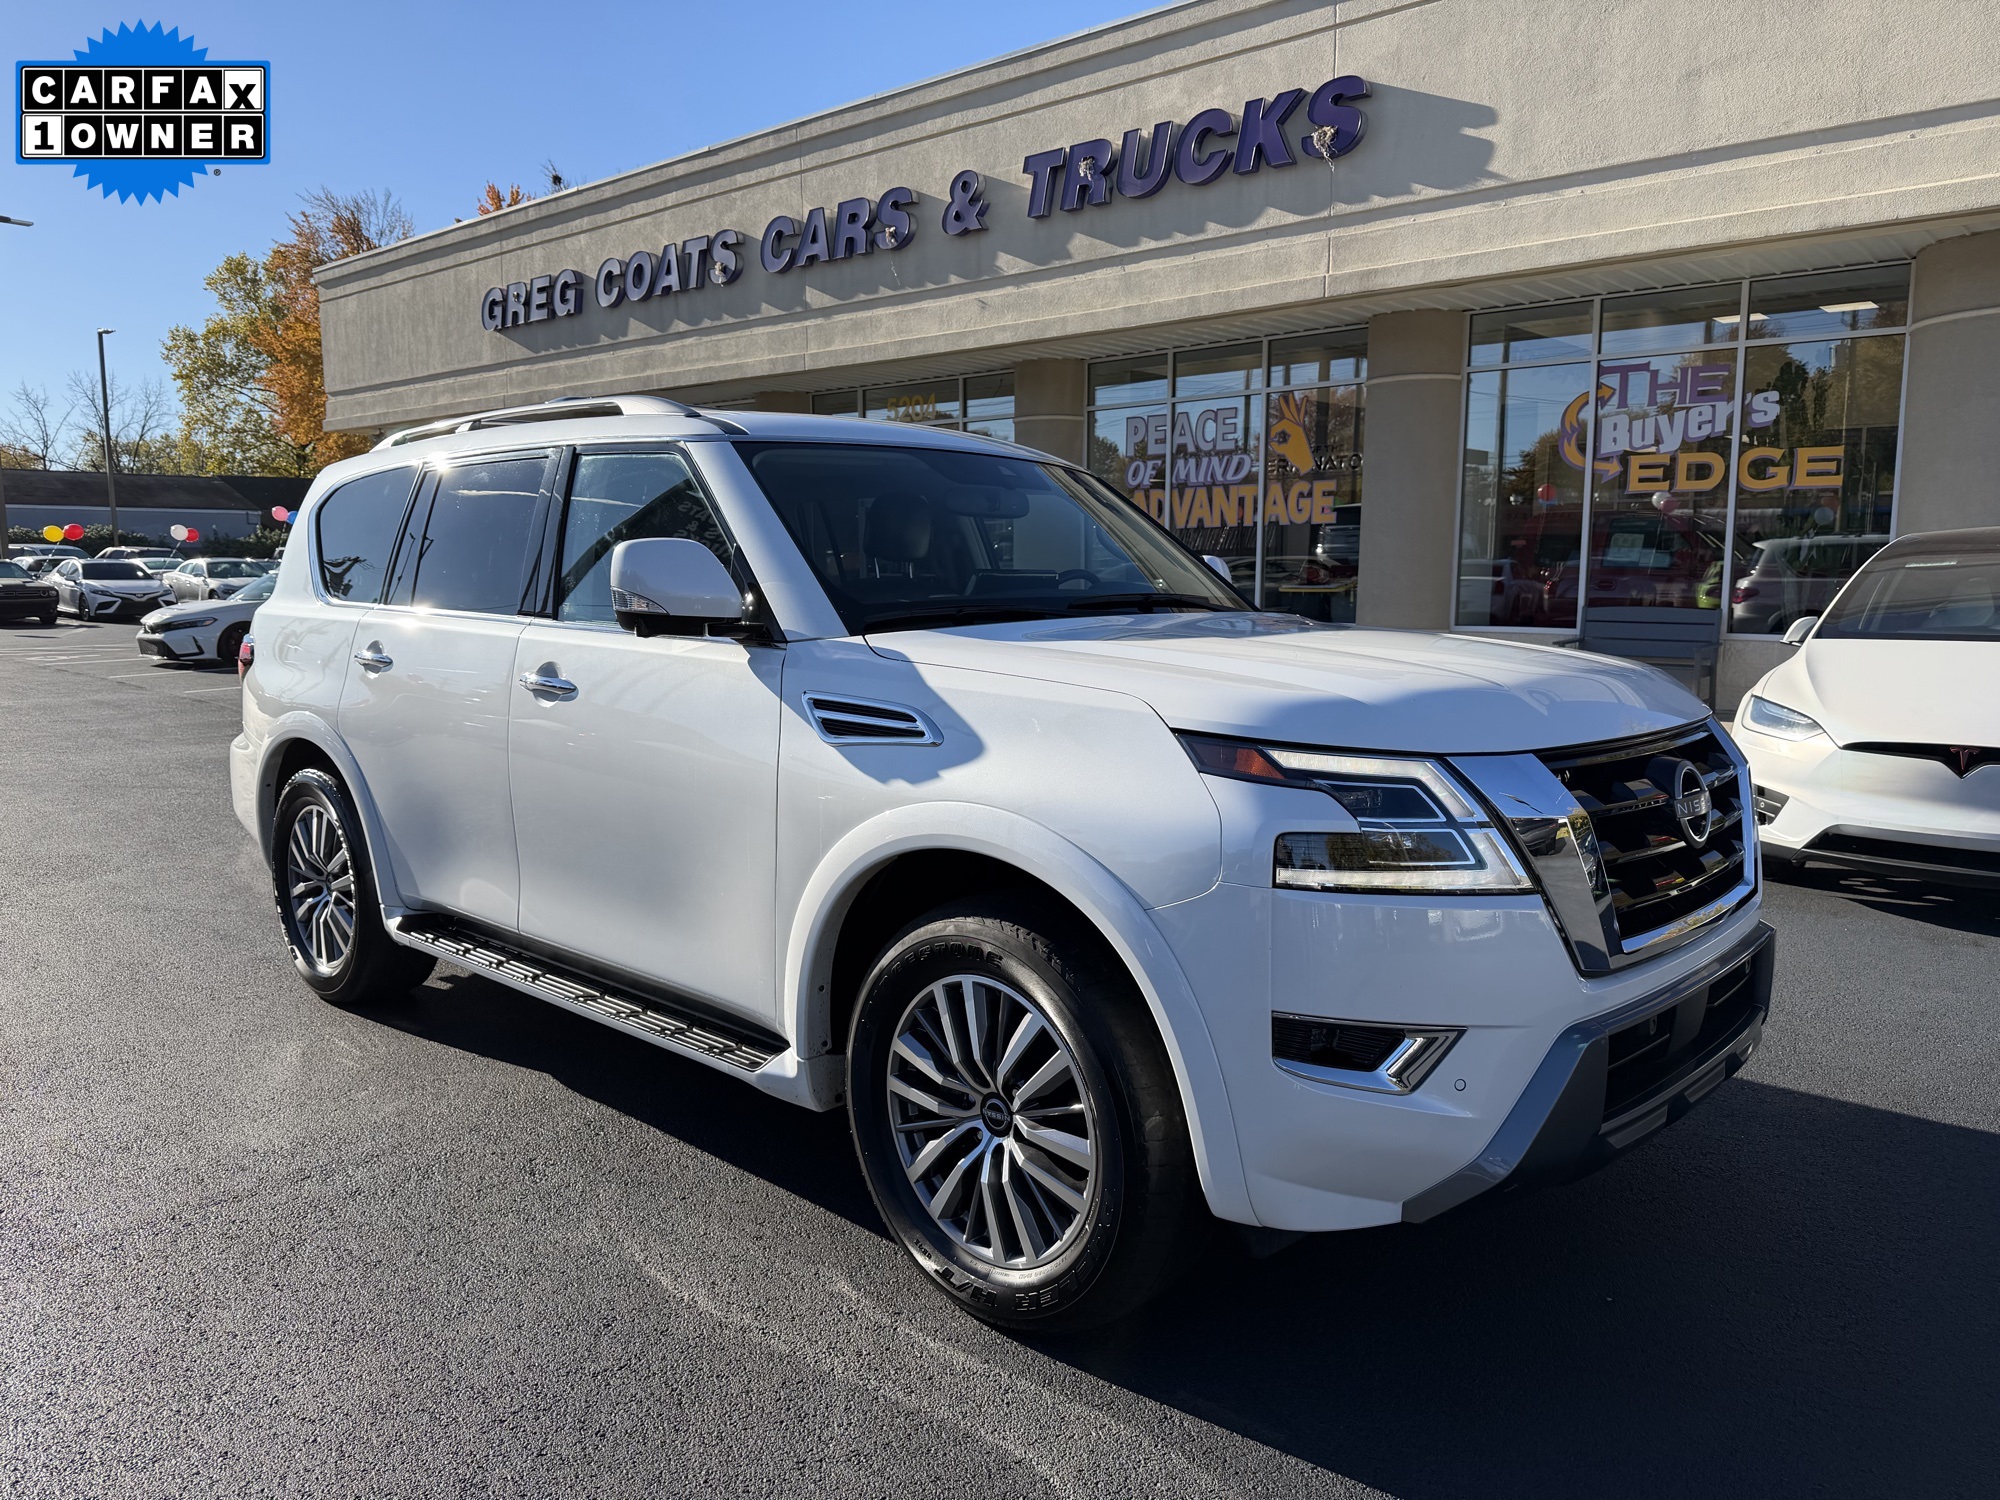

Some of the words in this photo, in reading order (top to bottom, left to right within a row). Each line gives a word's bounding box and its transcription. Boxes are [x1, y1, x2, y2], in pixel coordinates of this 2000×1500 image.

[481, 268, 584, 333] GREG
[594, 229, 745, 309] COATS
[760, 186, 919, 275] CARS
[941, 169, 990, 237] &
[1022, 75, 1373, 220] TRUCKS
[887, 393, 936, 422] 5204
[1599, 361, 1732, 411] THE
[1126, 406, 1238, 458] PEACE
[1600, 388, 1780, 456] Buyer's
[1125, 458, 1163, 489] OF
[1171, 454, 1252, 488] MIND
[1624, 445, 1845, 494] EDGE
[1677, 797, 1711, 815] NIS
